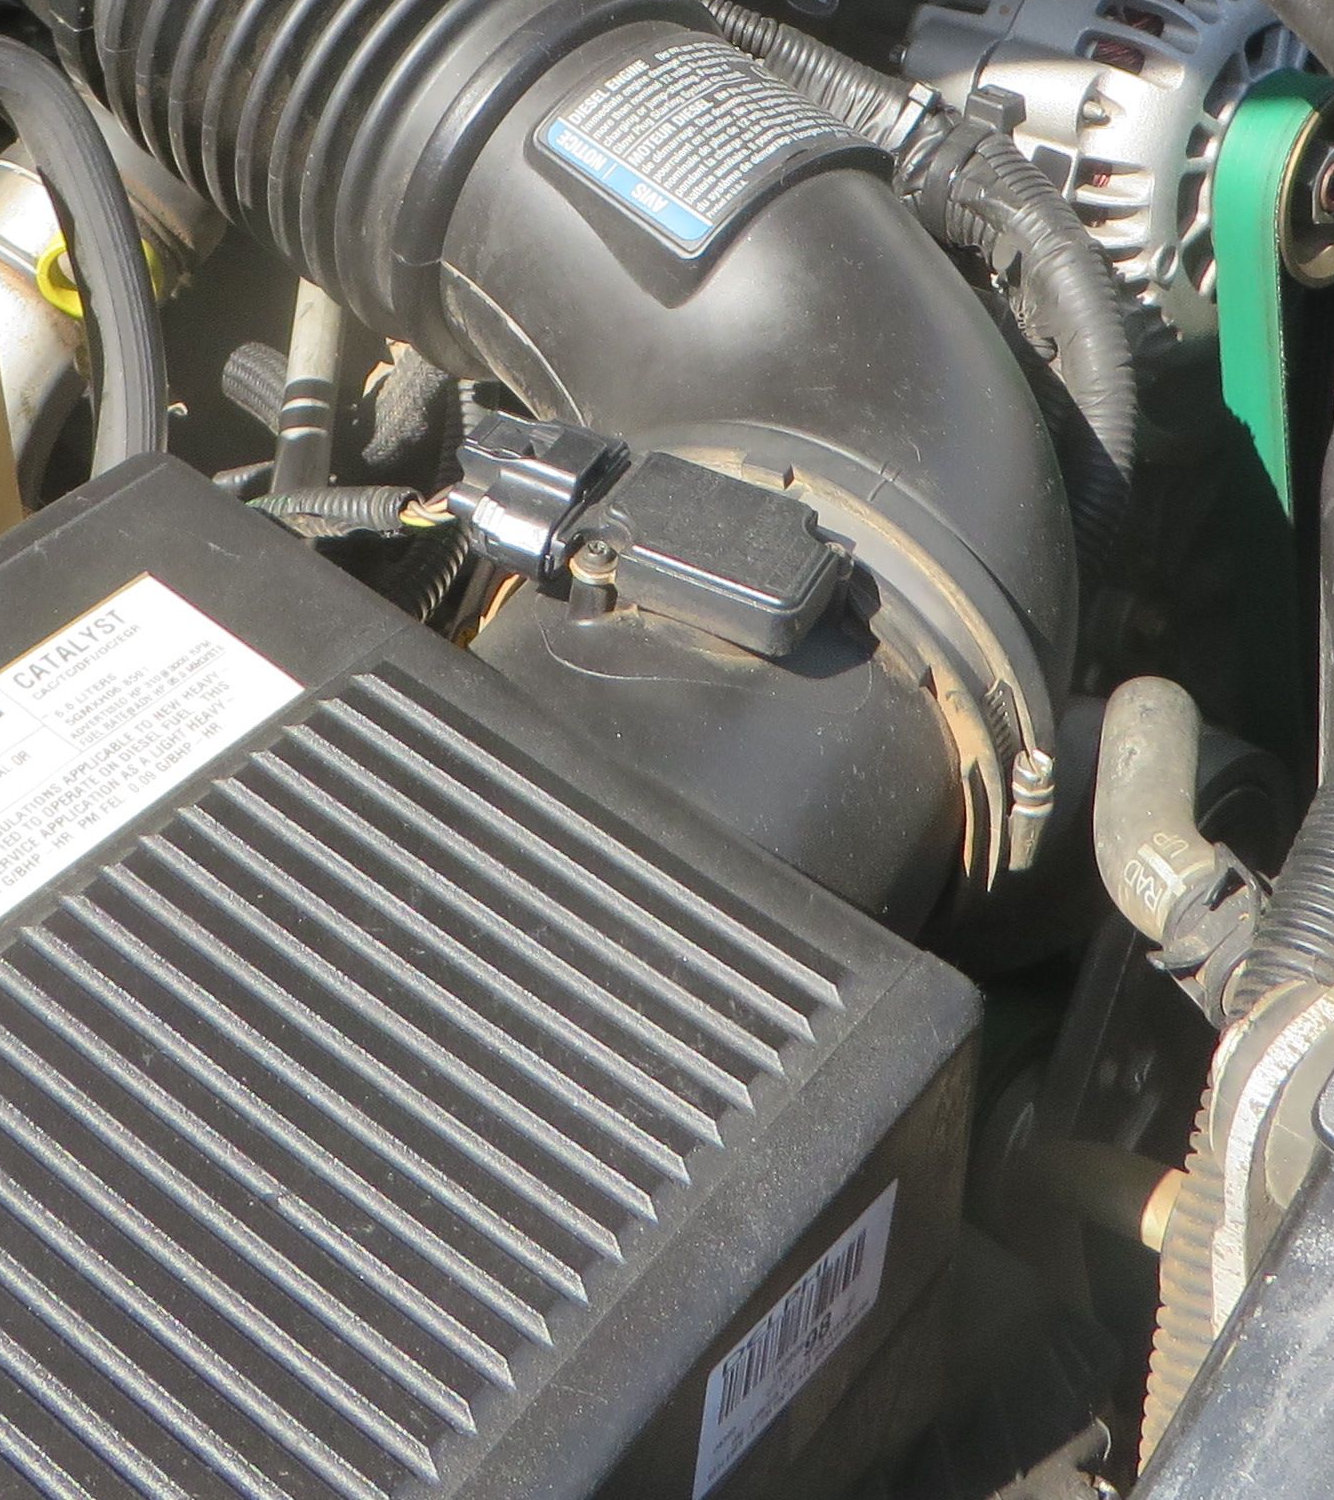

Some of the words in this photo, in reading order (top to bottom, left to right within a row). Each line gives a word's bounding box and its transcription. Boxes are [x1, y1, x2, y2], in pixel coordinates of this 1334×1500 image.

[568, 89, 611, 124] DIESEL
[604, 59, 650, 92] ENGINE
[581, 94, 624, 133] Immediate
[622, 75, 650, 97] engine
[593, 119, 615, 140] more
[611, 103, 633, 120] than
[630, 80, 663, 106] nominal
[659, 74, 673, 85] 12
[556, 132, 605, 171] NOTICE
[603, 113, 640, 147] charging
[636, 106, 647, 116] or
[613, 133, 635, 154] Glow
[631, 117, 655, 135] Plug
[649, 95, 685, 120] Starting
[628, 122, 677, 167] MOTEUR
[671, 98, 715, 127] DIESEL
[641, 161, 655, 174] de
[652, 125, 699, 163] démarrage.
[652, 142, 695, 183] pourraient
[691, 134, 705, 146] en
[663, 154, 701, 190] nominale
[698, 145, 712, 157] de
[709, 132, 730, 149] plus
[726, 125, 740, 136] de
[674, 164, 709, 198] pendant
[703, 157, 717, 167] la
[713, 138, 743, 160] charge
[696, 199, 710, 212] du
[707, 169, 743, 201] système
[739, 161, 753, 173] de
[631, 184, 669, 213] AVIS
[683, 175, 717, 205] batterie
[12, 608, 126, 690] CATALYST
[74, 672, 117, 704] LITERS
[10, 749, 32, 766] OR
[21, 816, 43, 831] TO
[41, 774, 101, 818] OPERATE
[98, 760, 120, 778] ON
[117, 731, 164, 763] DIESEL
[198, 680, 231, 702] THIS
[61, 731, 136, 786] APPLICABLE
[133, 719, 154, 734] TO
[151, 698, 182, 722] NEW
[39, 777, 121, 840] APPLICATION
[120, 763, 140, 781] AS
[138, 756, 152, 767] A
[149, 726, 187, 759] LIGHT
[77, 811, 101, 830] PM
[98, 795, 125, 815] FEL
[127, 770, 157, 794] 0.09
[1153, 832, 1189, 859] UP
[1124, 859, 1164, 917] RAD
